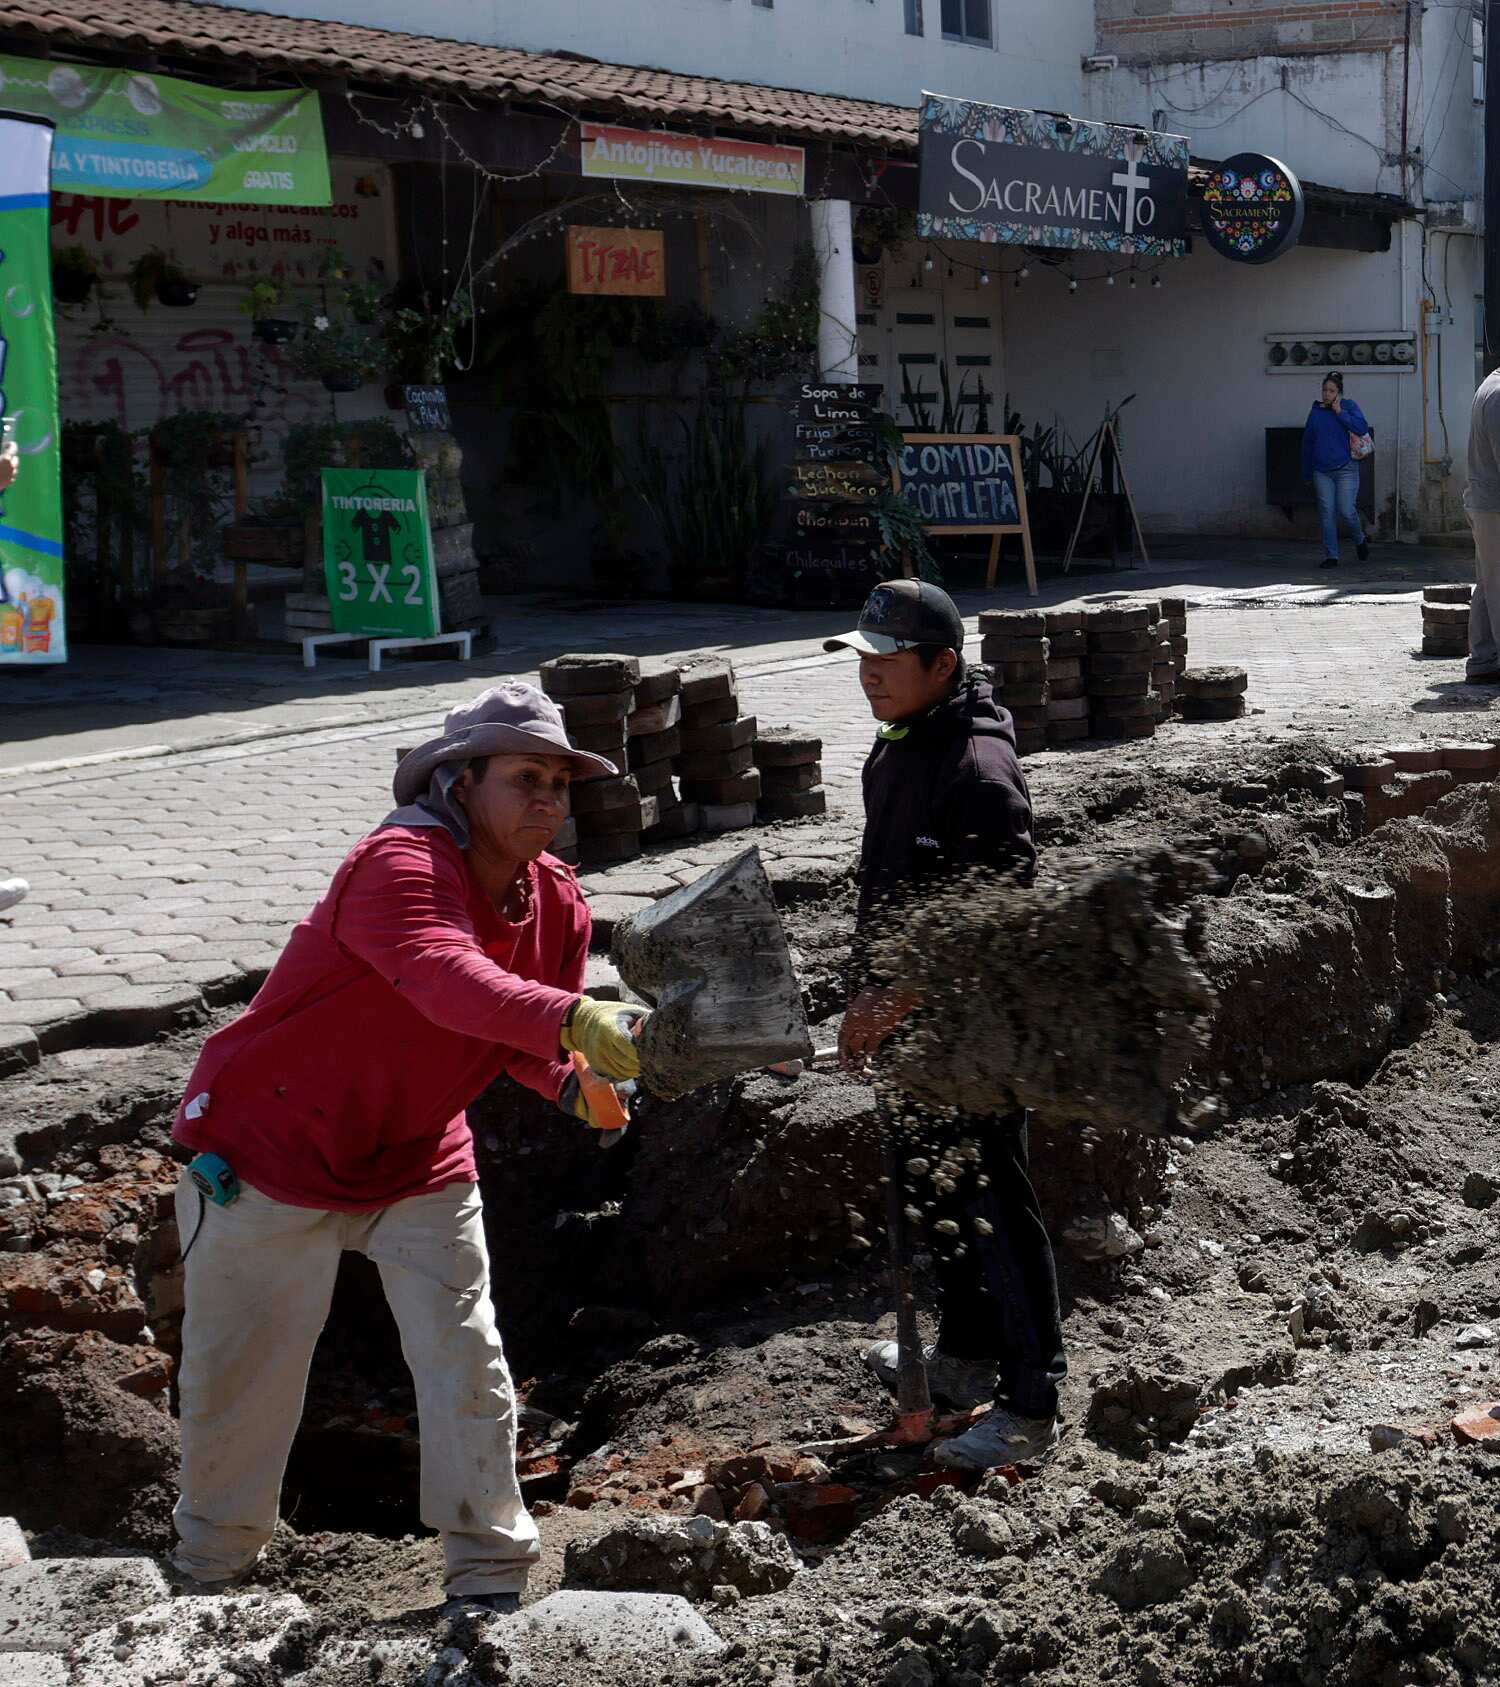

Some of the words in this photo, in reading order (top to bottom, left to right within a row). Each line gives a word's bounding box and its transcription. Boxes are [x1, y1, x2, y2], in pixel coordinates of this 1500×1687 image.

[591, 137, 694, 174] Antojitos
[699, 146, 798, 181] Yucatecos
[243, 170, 295, 190] GRATIS
[209, 223, 221, 244] y
[225, 221, 269, 246] algo
[272, 224, 313, 244] más
[800, 384, 839, 403] Sopa
[813, 403, 861, 420] Lima
[898, 443, 1014, 477] COMIDA
[903, 477, 1019, 520] COMPLETA
[337, 561, 358, 601] 3
[401, 565, 425, 606] 2
